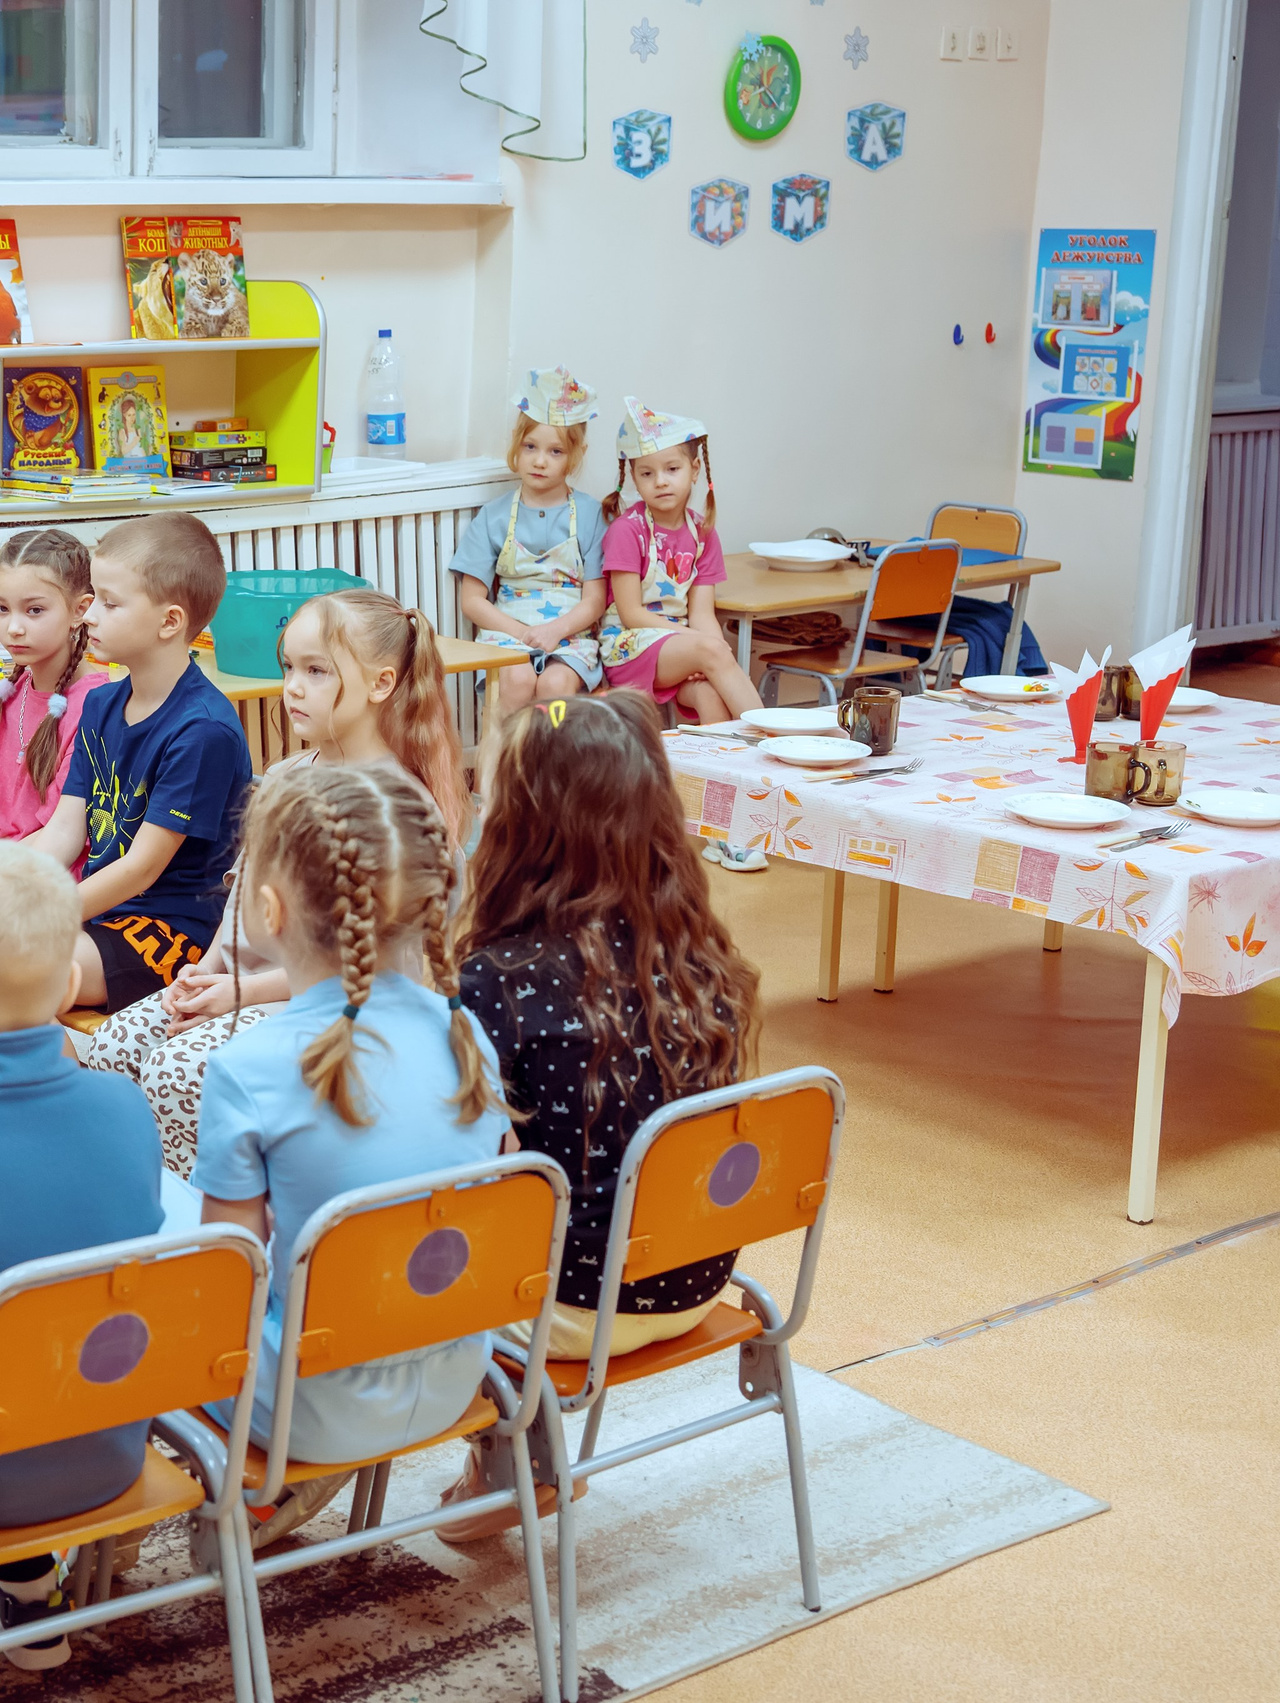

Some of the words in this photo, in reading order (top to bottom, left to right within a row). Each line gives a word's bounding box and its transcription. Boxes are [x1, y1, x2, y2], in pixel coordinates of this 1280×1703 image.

[146, 229, 165, 238] БОЛЬ
[138, 238, 167, 252] КОШ
[183, 237, 229, 249] ЖИВОТНЫХ
[1068, 234, 1129, 248] УГОЛОК
[1051, 250, 1144, 265] ДЕЖУРСТВА
[169, 808, 192, 821] DEMIX
